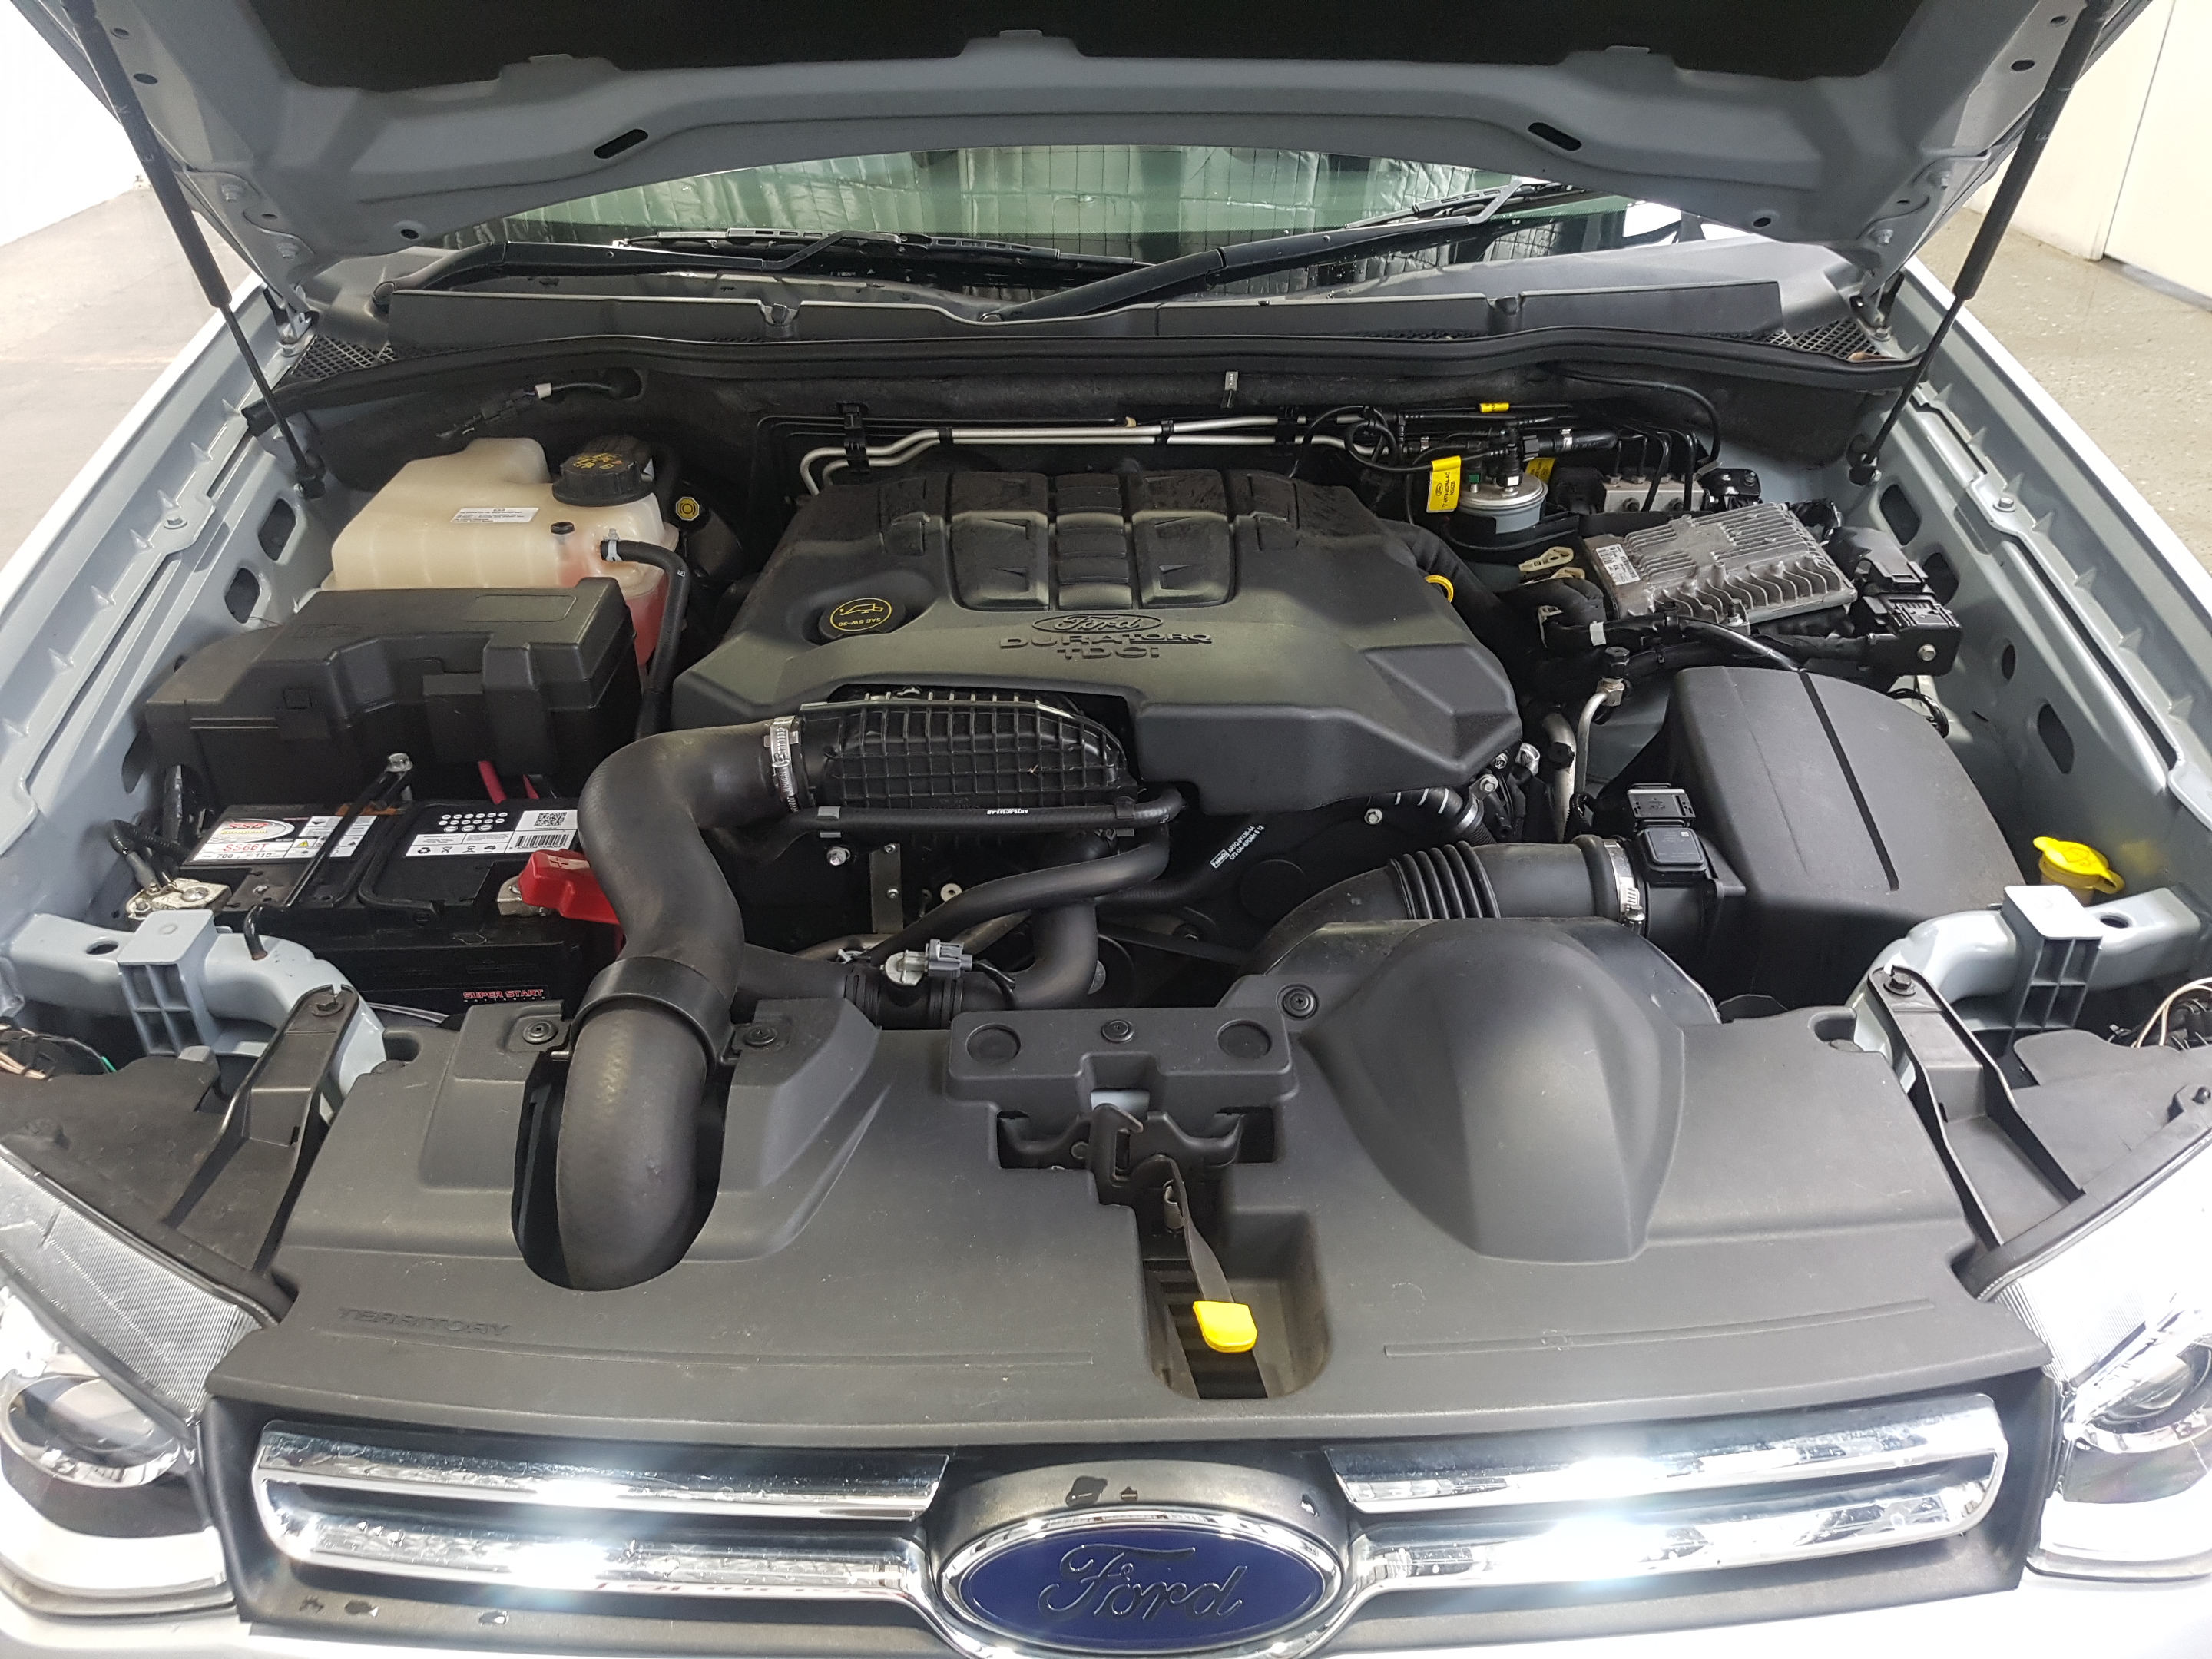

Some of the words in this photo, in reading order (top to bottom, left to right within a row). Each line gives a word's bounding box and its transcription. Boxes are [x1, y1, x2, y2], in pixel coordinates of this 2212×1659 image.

[1054, 614, 1141, 631] Ford
[1000, 634, 1213, 649] DURATORQ
[505, 988, 544, 998] START
[338, 1306, 512, 1336] TERRITORY
[1038, 1543, 1249, 1620] Ford
